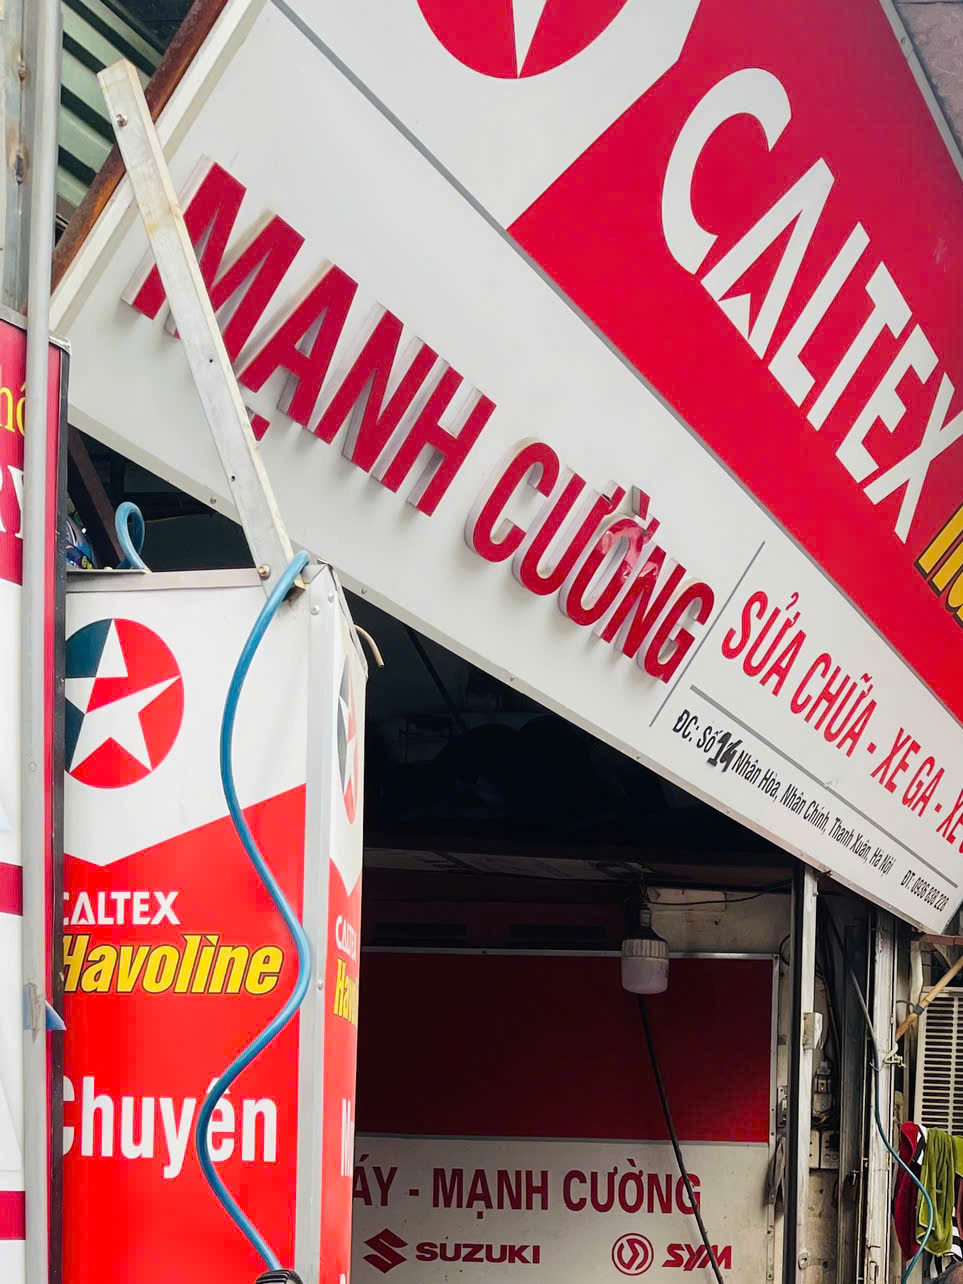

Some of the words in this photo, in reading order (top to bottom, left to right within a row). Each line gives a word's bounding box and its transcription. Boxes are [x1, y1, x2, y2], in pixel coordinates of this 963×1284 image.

[122, 155, 497, 517] MẠNH
[465, 437, 715, 684] CƯỜNG
[721, 591, 807, 697] SỬA
[790, 652, 877, 759] CHỮA
[870, 727, 922, 794] XE
[902, 757, 945, 818] GA
[672, 709, 700, 742] ĐC:
[696, 726, 723, 753] Số
[731, 750, 762, 785] Nhân
[780, 783, 806, 816] Nhân
[803, 800, 830, 835] Chính,
[828, 817, 855, 848] Thanh
[869, 847, 882, 872] Hà
[878, 852, 897, 878] Nội
[63, 932, 285, 996] Havoline
[353, 1154, 399, 1207] ÁY
[432, 1167, 549, 1220] MẠNH
[563, 1158, 702, 1216] CƯỜNG
[415, 1242, 541, 1264] SUZUKI
[661, 1243, 732, 1271] SYM
